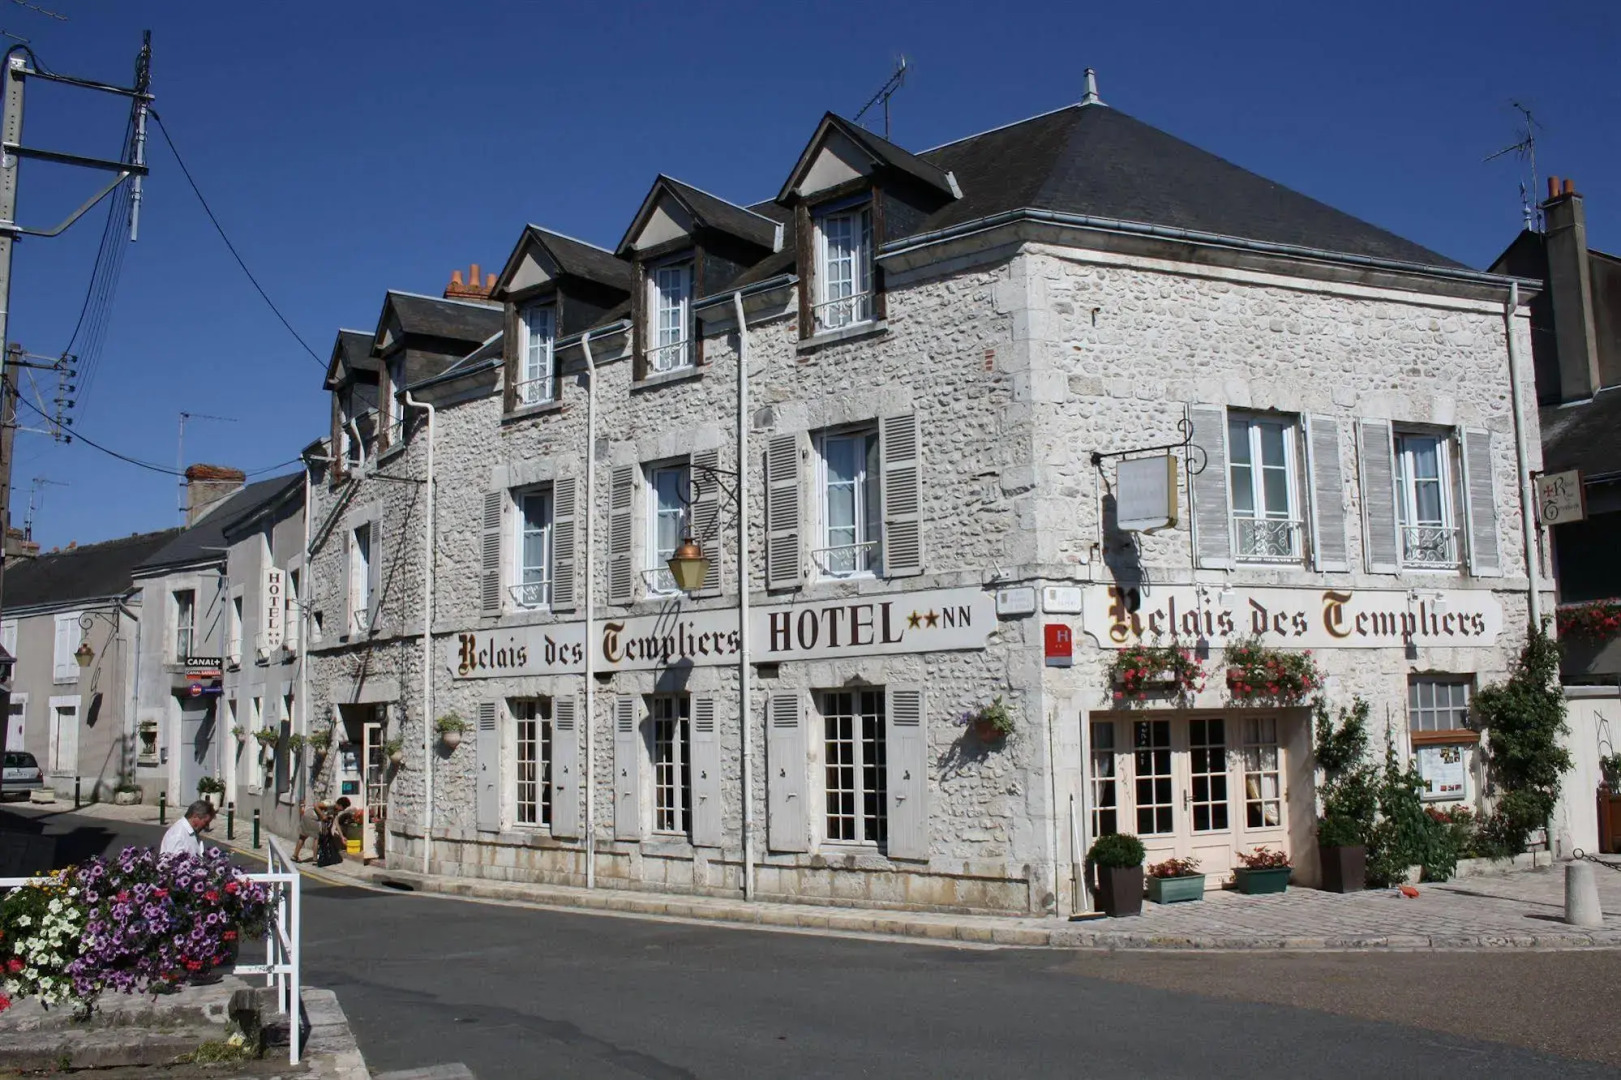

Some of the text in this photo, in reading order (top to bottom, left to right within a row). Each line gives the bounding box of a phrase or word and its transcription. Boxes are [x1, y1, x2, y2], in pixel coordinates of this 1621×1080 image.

[268, 573, 280, 629] HOTEL
[767, 601, 972, 652] HOTEL NN
[1108, 586, 1486, 643] Relais des Templiers
[187, 658, 220, 666] CANAL+
[458, 620, 741, 676] Relais des Templiers
